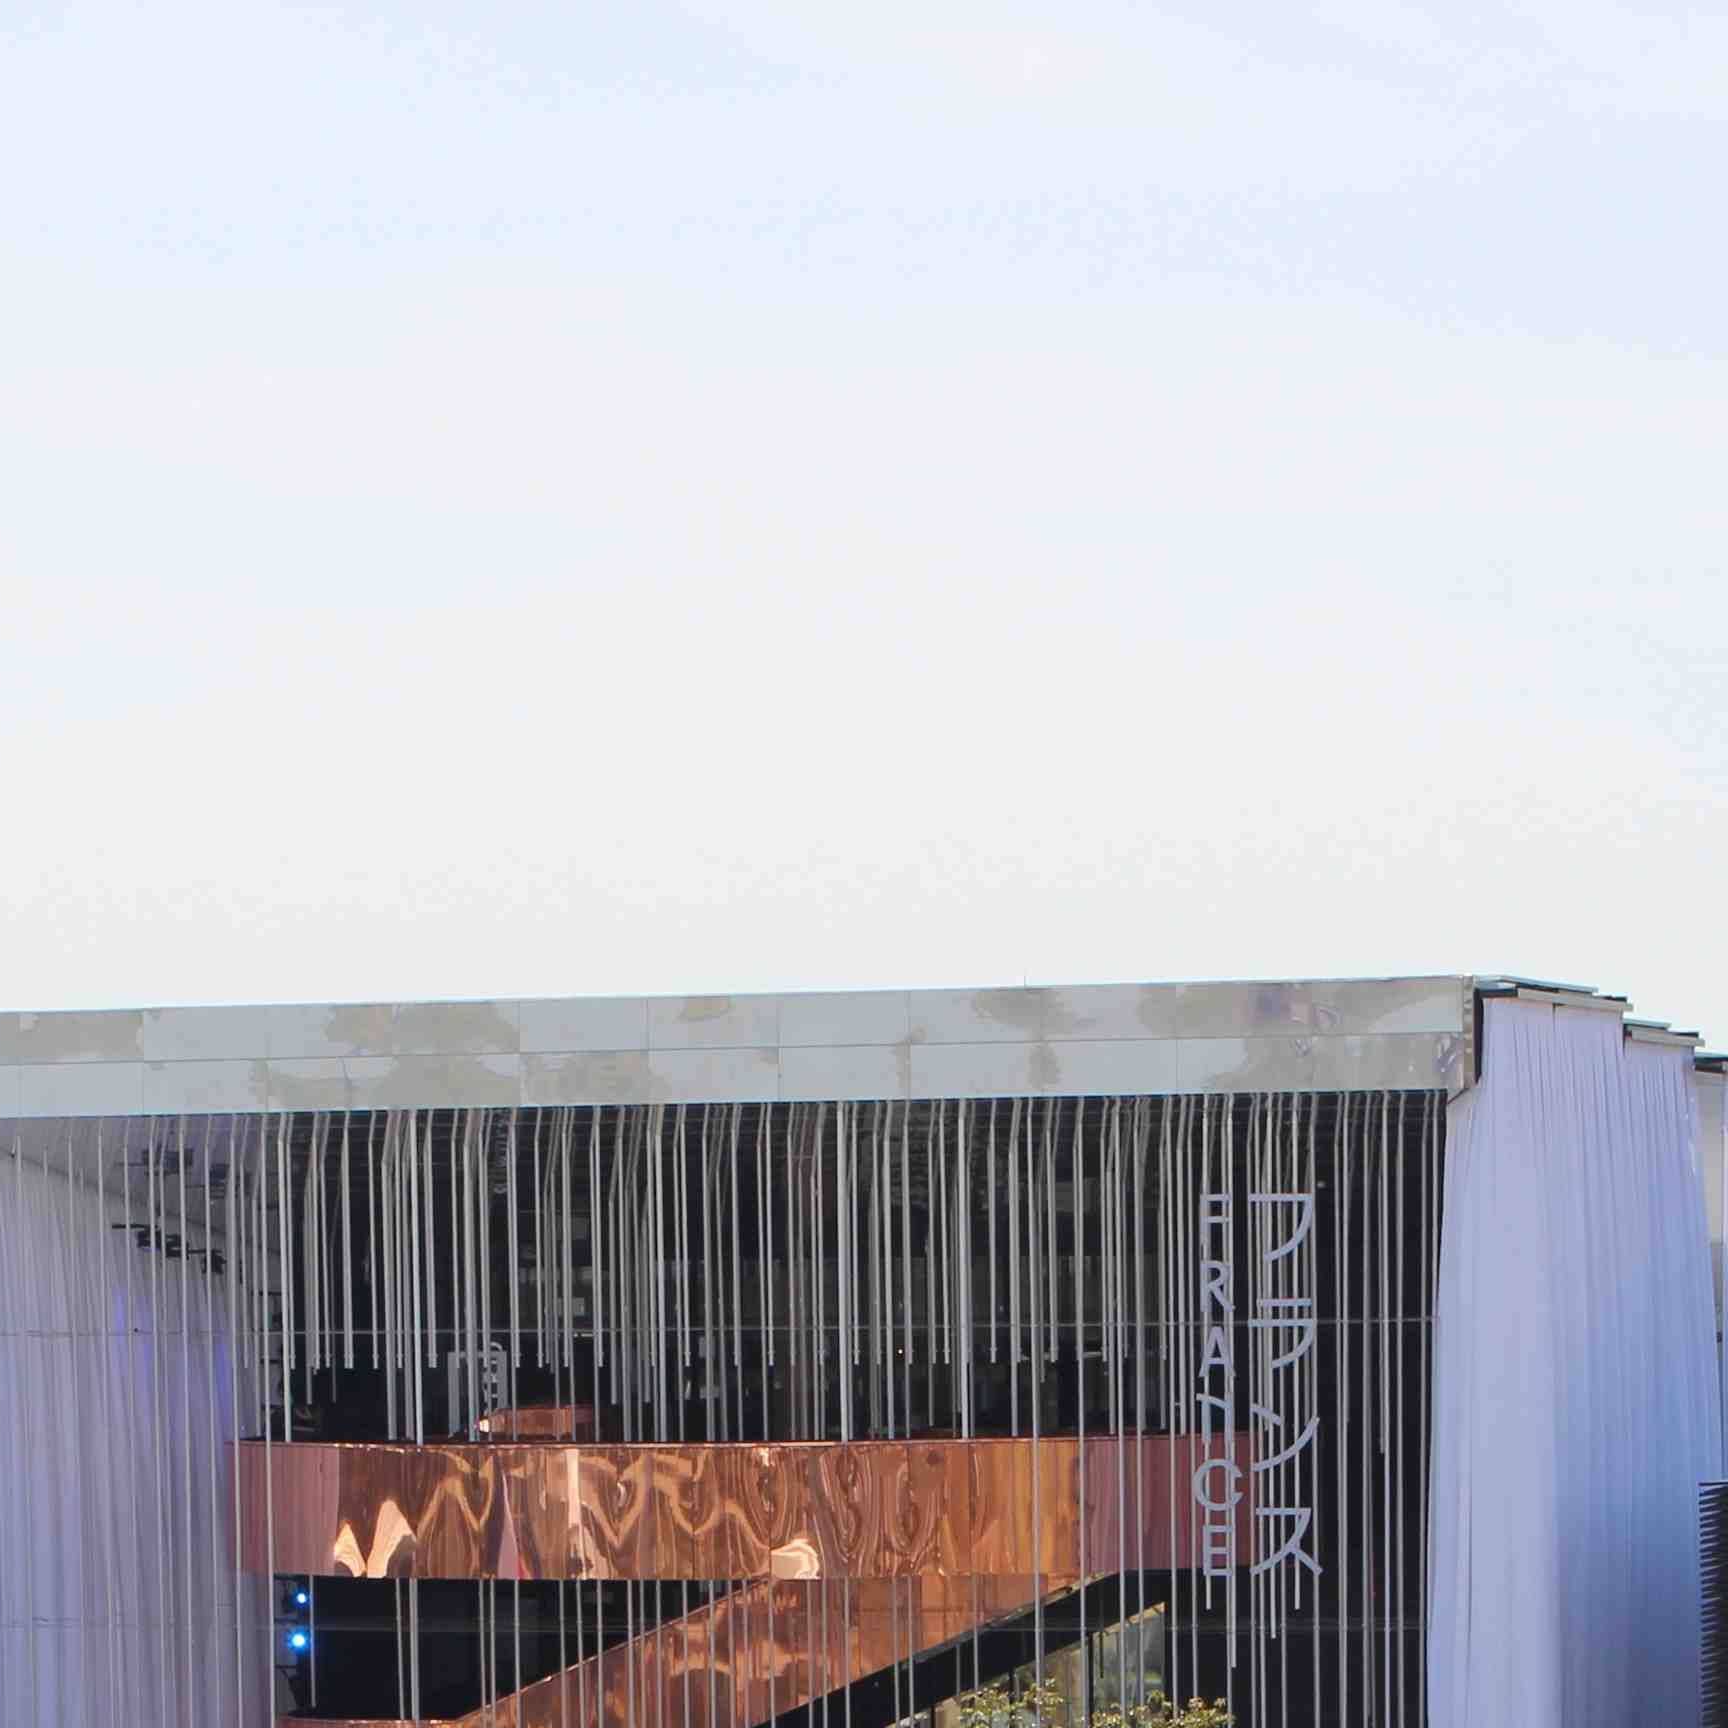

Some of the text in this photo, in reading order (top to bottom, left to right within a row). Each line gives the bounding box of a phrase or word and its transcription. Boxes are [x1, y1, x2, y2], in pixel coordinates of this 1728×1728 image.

[1192, 1193, 1243, 1577] FRANCE
[1247, 1193, 1323, 1575] フランス
